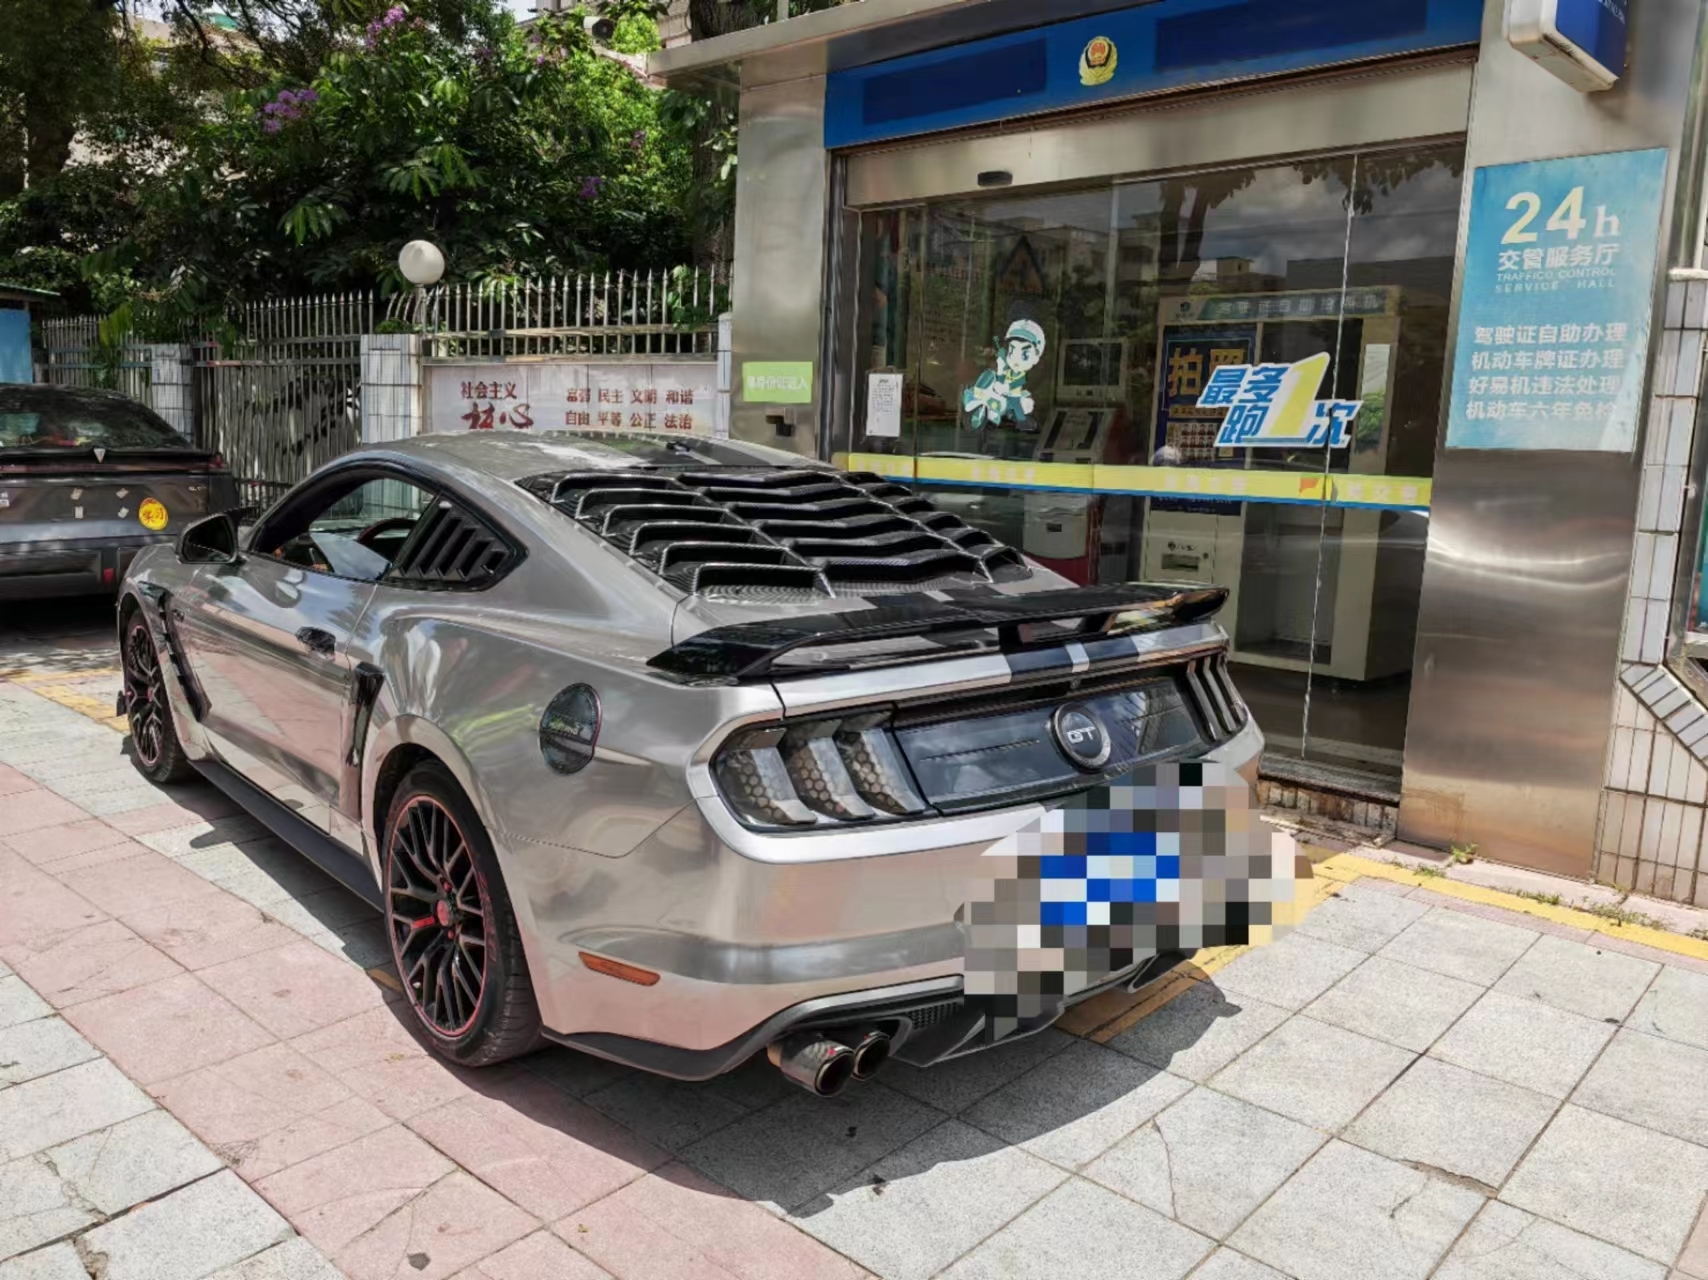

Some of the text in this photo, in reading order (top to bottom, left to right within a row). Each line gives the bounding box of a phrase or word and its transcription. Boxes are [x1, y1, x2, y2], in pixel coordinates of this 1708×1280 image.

[1500, 186, 1620, 244] 24h
[1498, 243, 1619, 271] 交管服务厅
[1557, 266, 1616, 279] CONTROL
[1496, 279, 1616, 293] SERVICE HALL
[1474, 322, 1628, 345] 驾驶证自助办理
[1472, 349, 1624, 371] 机动车牌证办理
[461, 381, 517, 400] 社会主义
[1469, 374, 1623, 396] 好易机违法处理
[566, 388, 694, 405] 富强 民主 文明 和谐
[566, 410, 693, 430] 自由 平等 公正 法治
[1066, 726, 1096, 744] GT
